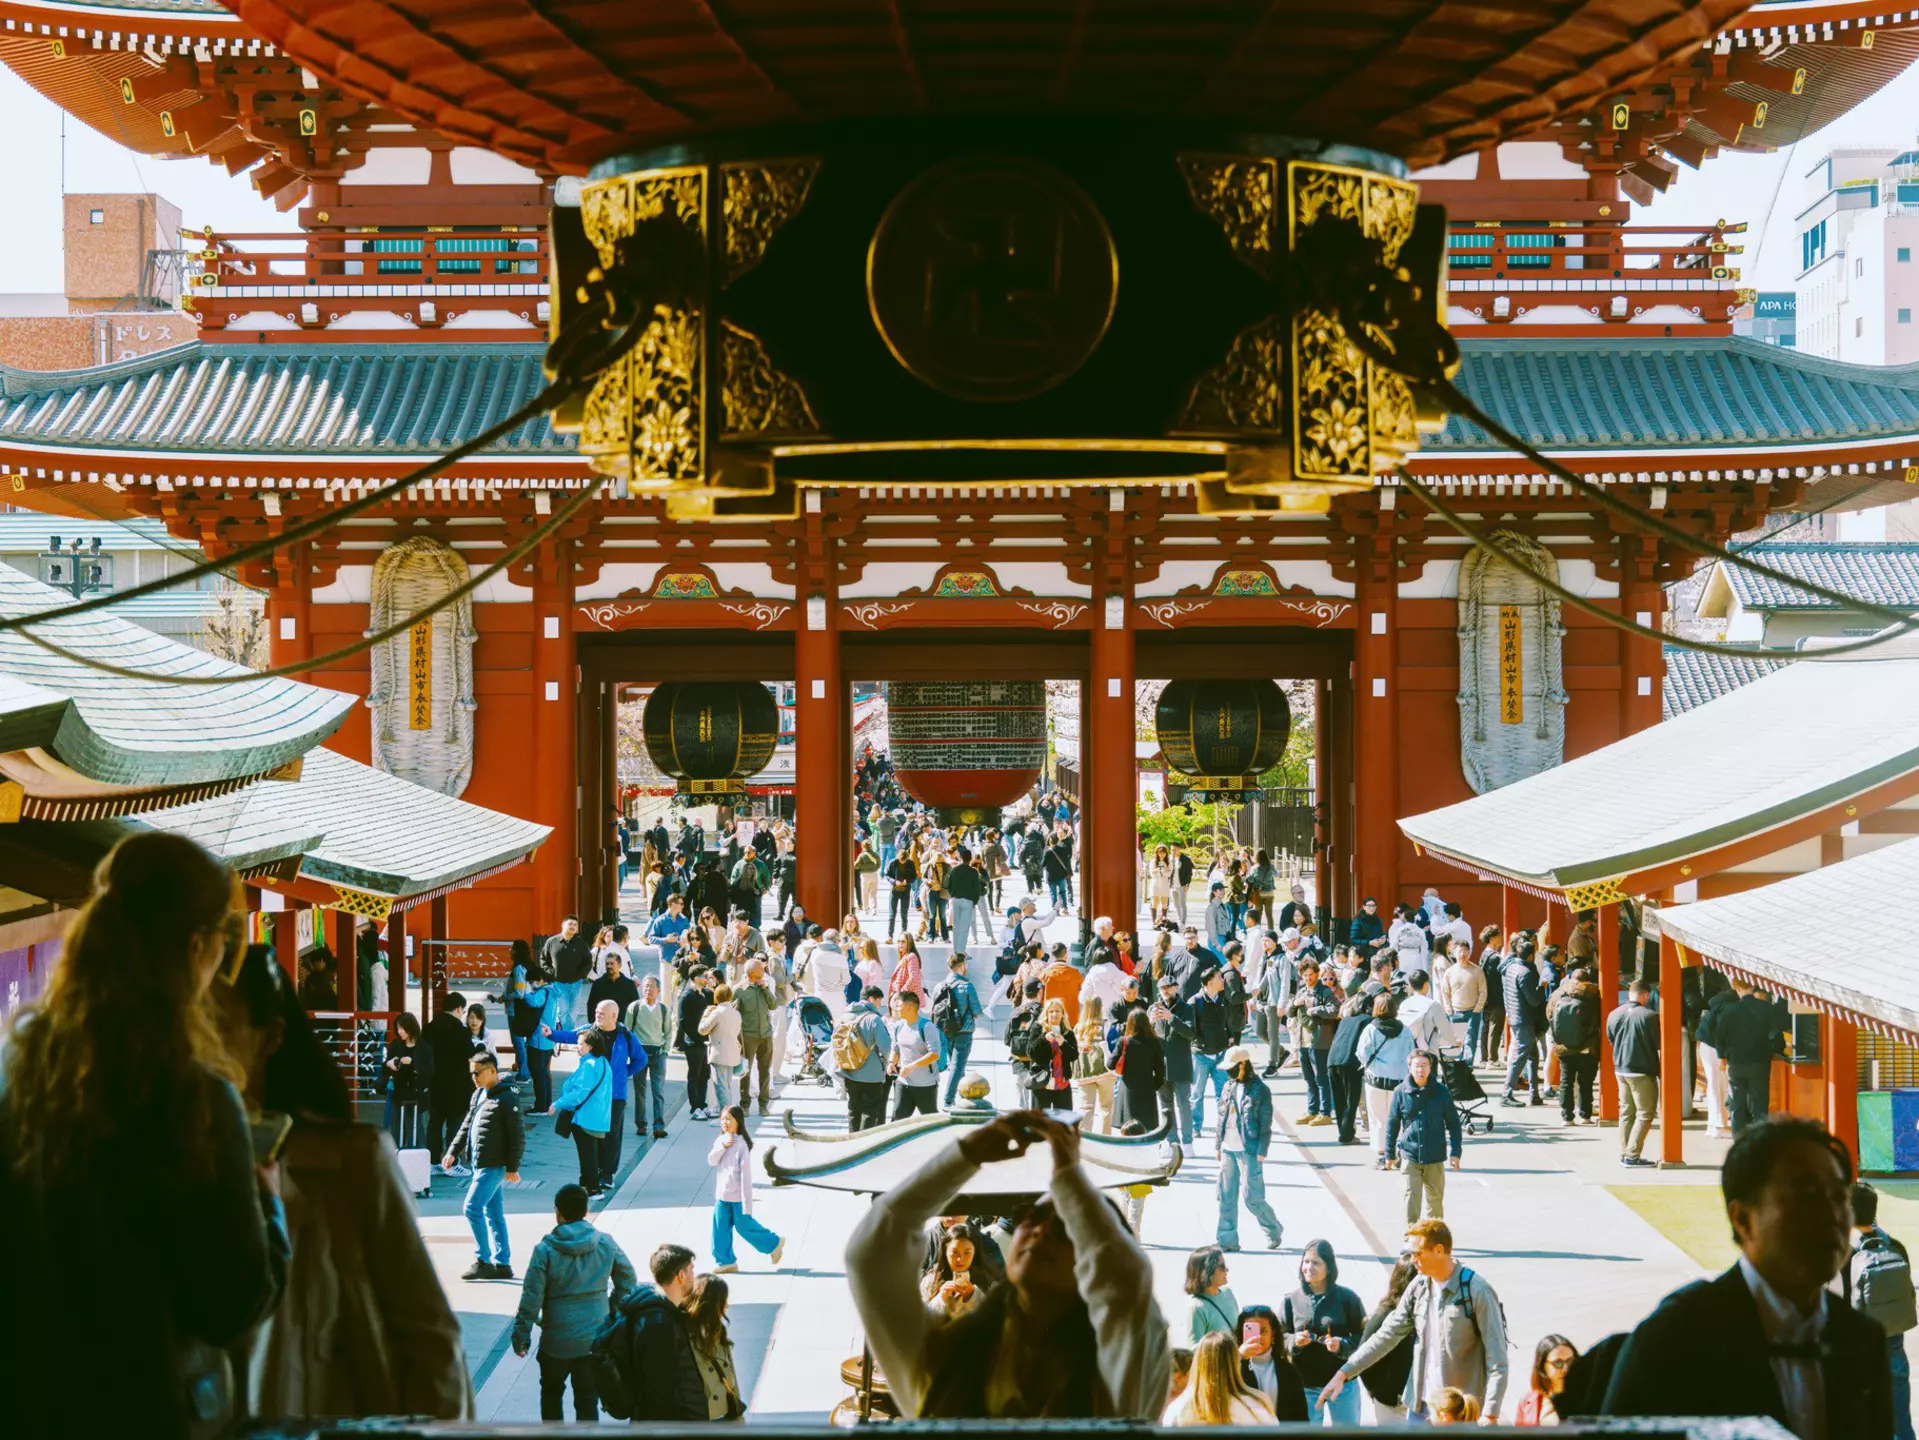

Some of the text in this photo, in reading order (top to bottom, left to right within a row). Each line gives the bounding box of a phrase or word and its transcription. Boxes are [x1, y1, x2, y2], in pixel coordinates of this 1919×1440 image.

[1760, 301, 1782, 310] APA
[116, 324, 171, 341] ドレス
[780, 760, 790, 768] 浅
